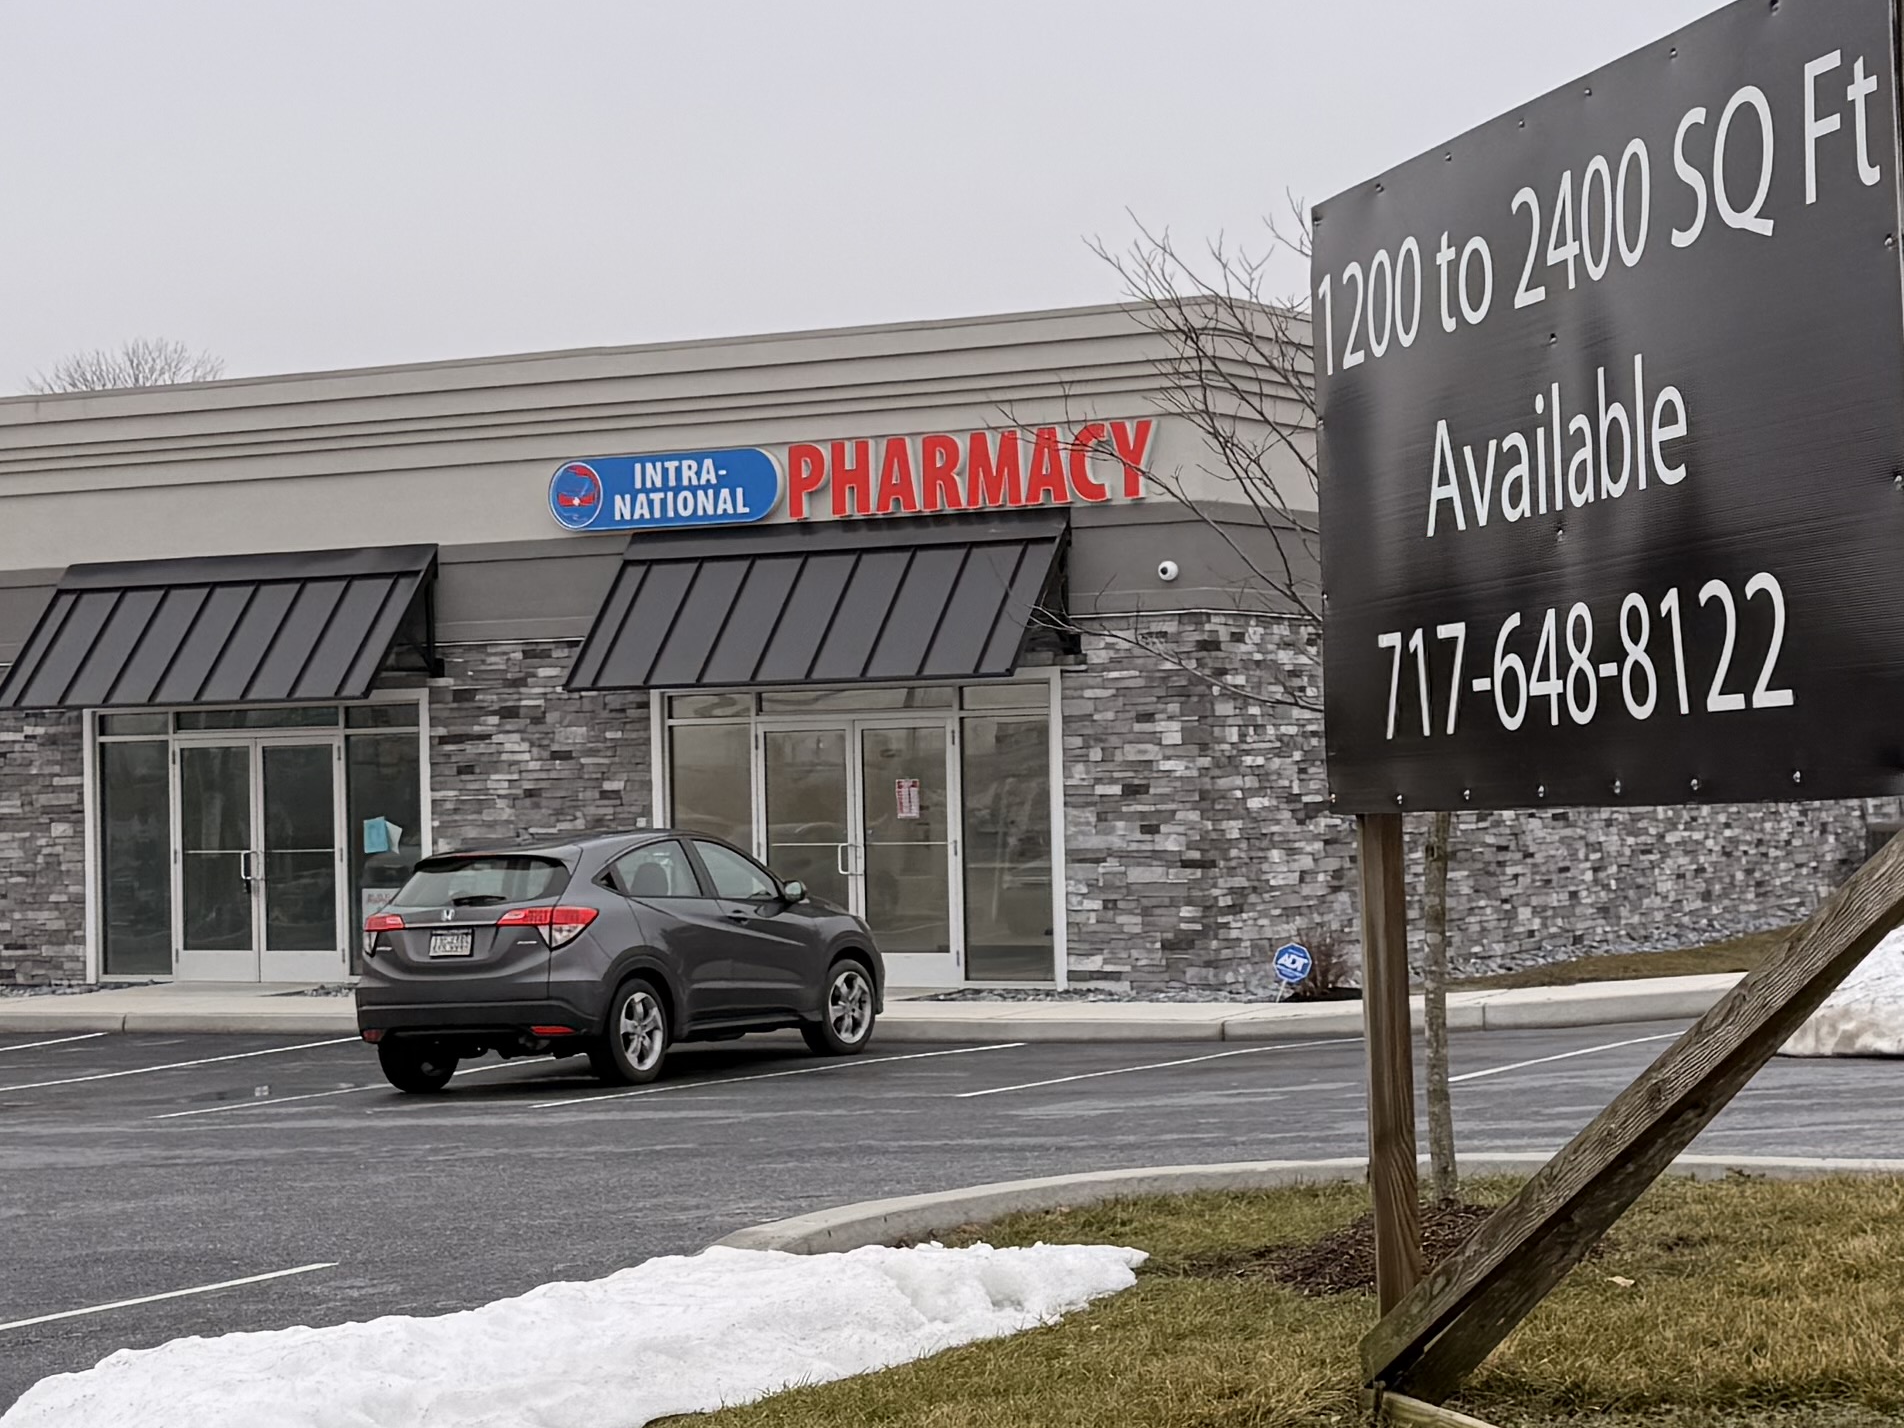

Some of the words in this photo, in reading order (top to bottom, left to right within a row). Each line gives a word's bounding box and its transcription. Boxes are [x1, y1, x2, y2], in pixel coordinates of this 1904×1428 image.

[1319, 235, 1422, 376] 1200
[1435, 230, 1493, 333] to
[1511, 137, 1650, 310] 2400
[1671, 85, 1775, 248] SQ
[1804, 49, 1882, 205] Ft
[634, 458, 727, 490] INTRA-
[788, 419, 1153, 520] PHARMACY
[1427, 353, 1688, 538] Available
[614, 487, 750, 521] NATIONAL
[1378, 573, 1794, 740] 717-648-8122
[1277, 953, 1308, 972] ADT
